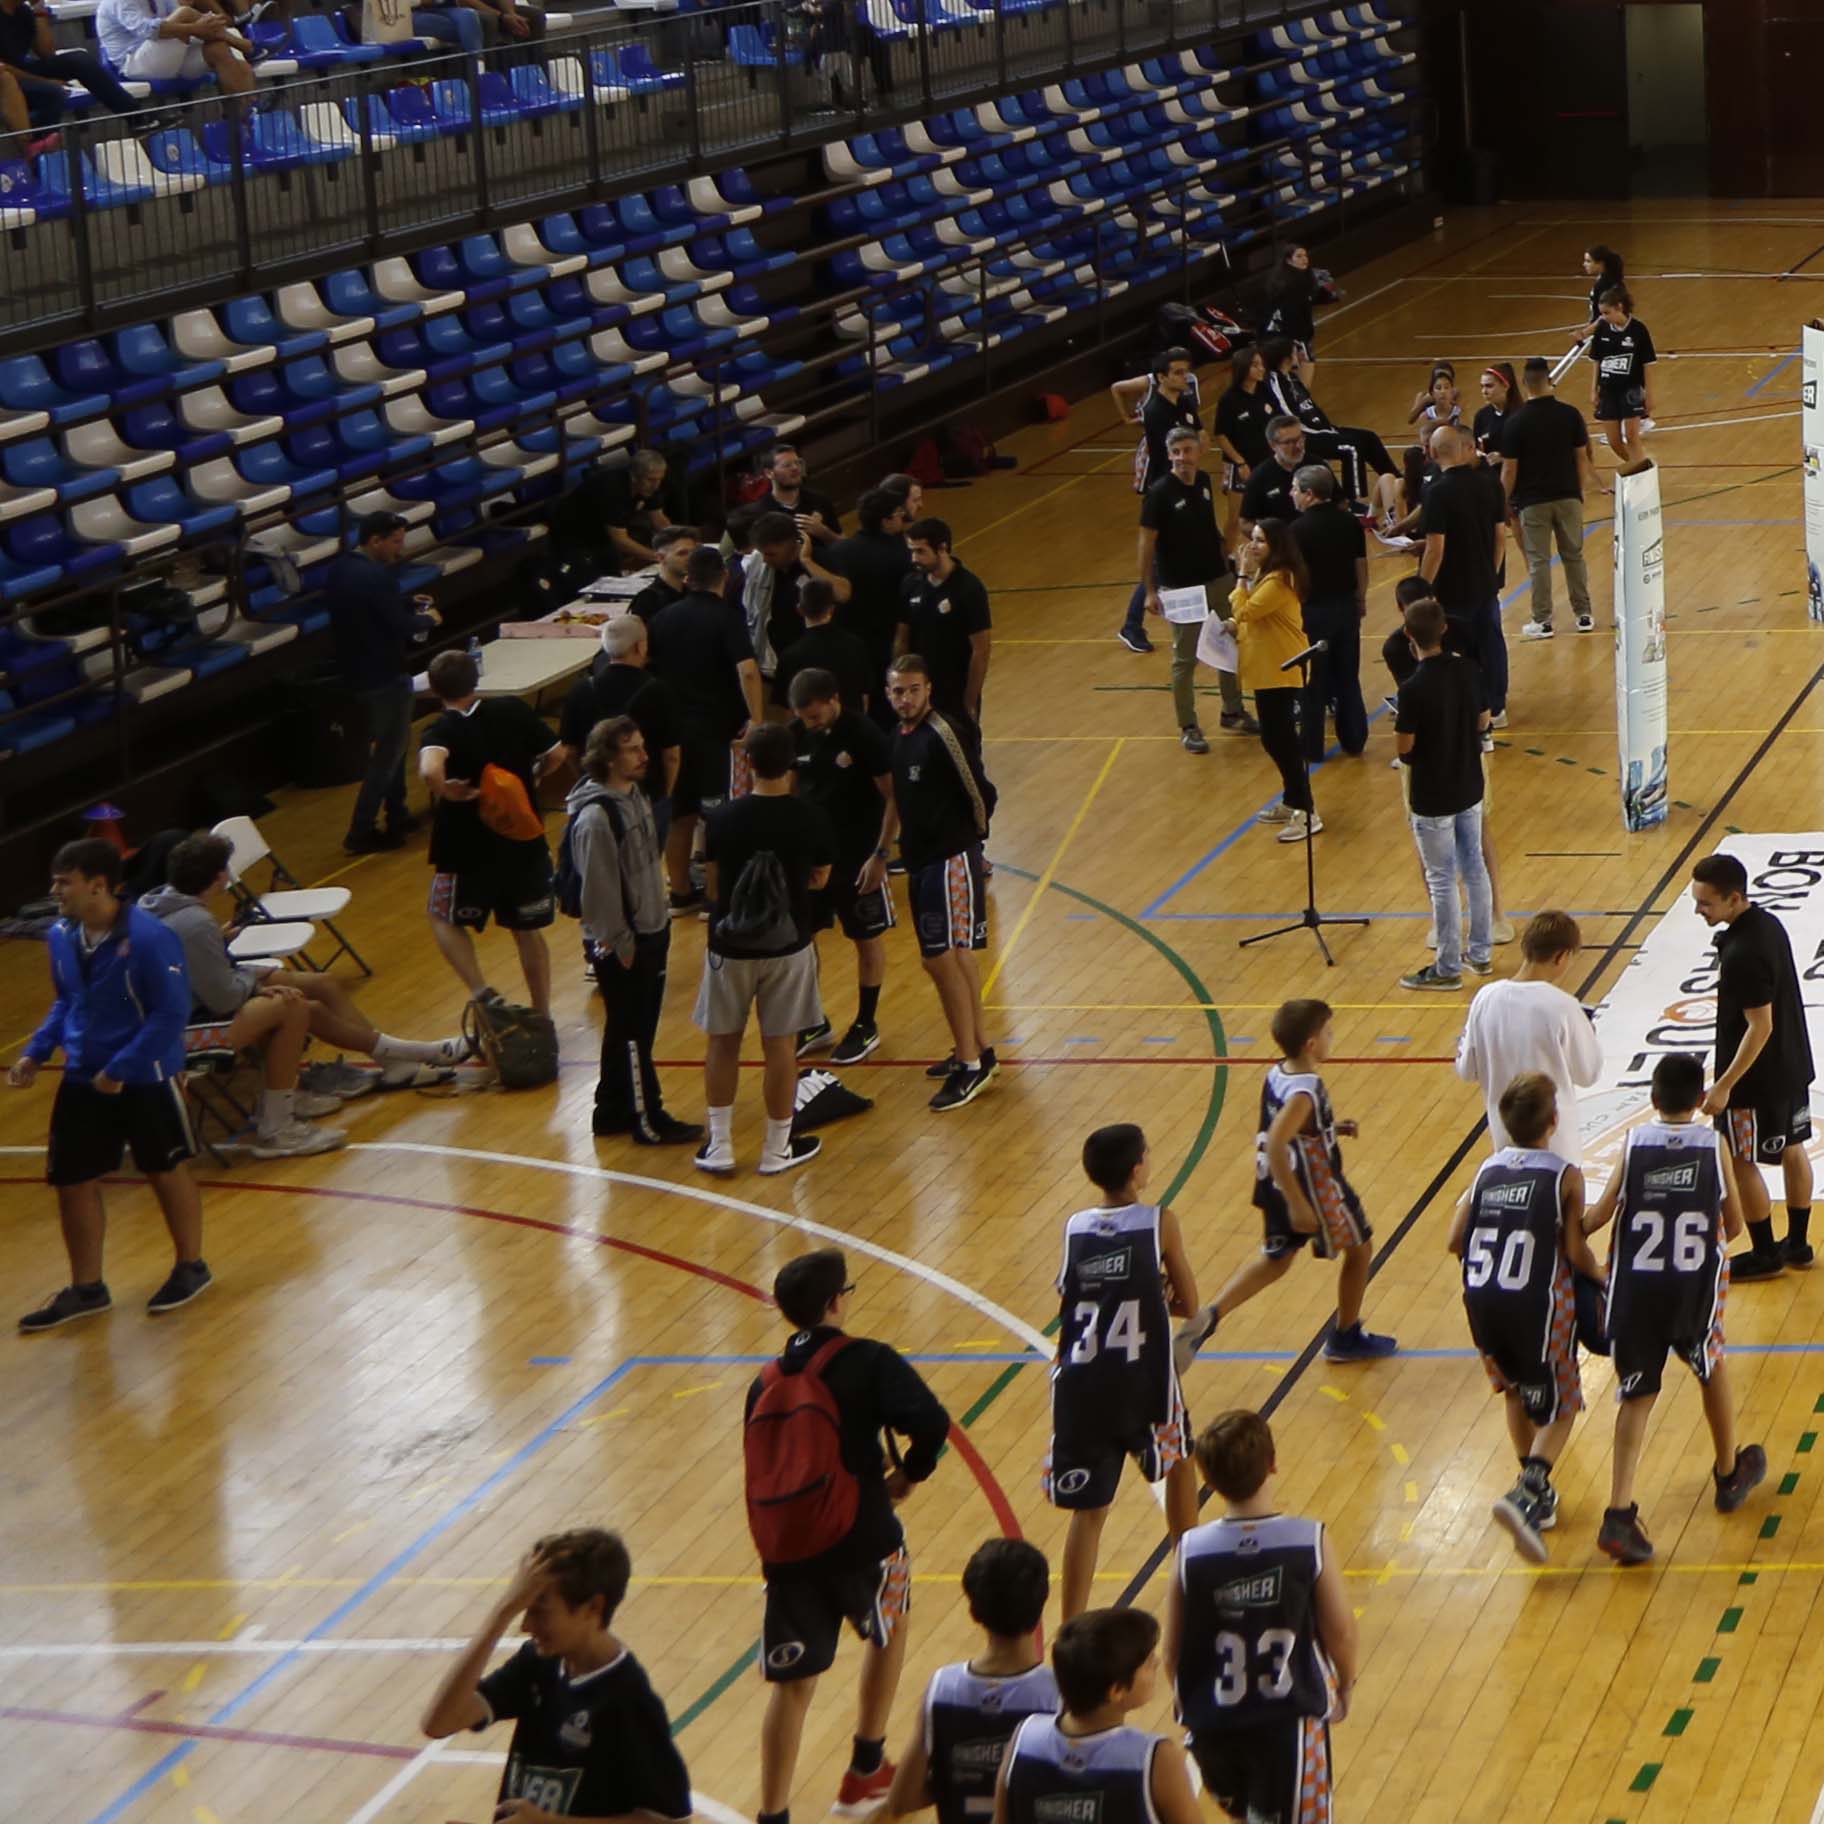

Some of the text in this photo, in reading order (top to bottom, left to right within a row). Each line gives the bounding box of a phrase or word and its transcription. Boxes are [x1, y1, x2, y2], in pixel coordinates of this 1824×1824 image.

[1467, 1227, 1535, 1291] 50
[1631, 1211, 1709, 1271] 26
[1071, 1299, 1146, 1364] 34
[1214, 1629, 1296, 1707] 33
